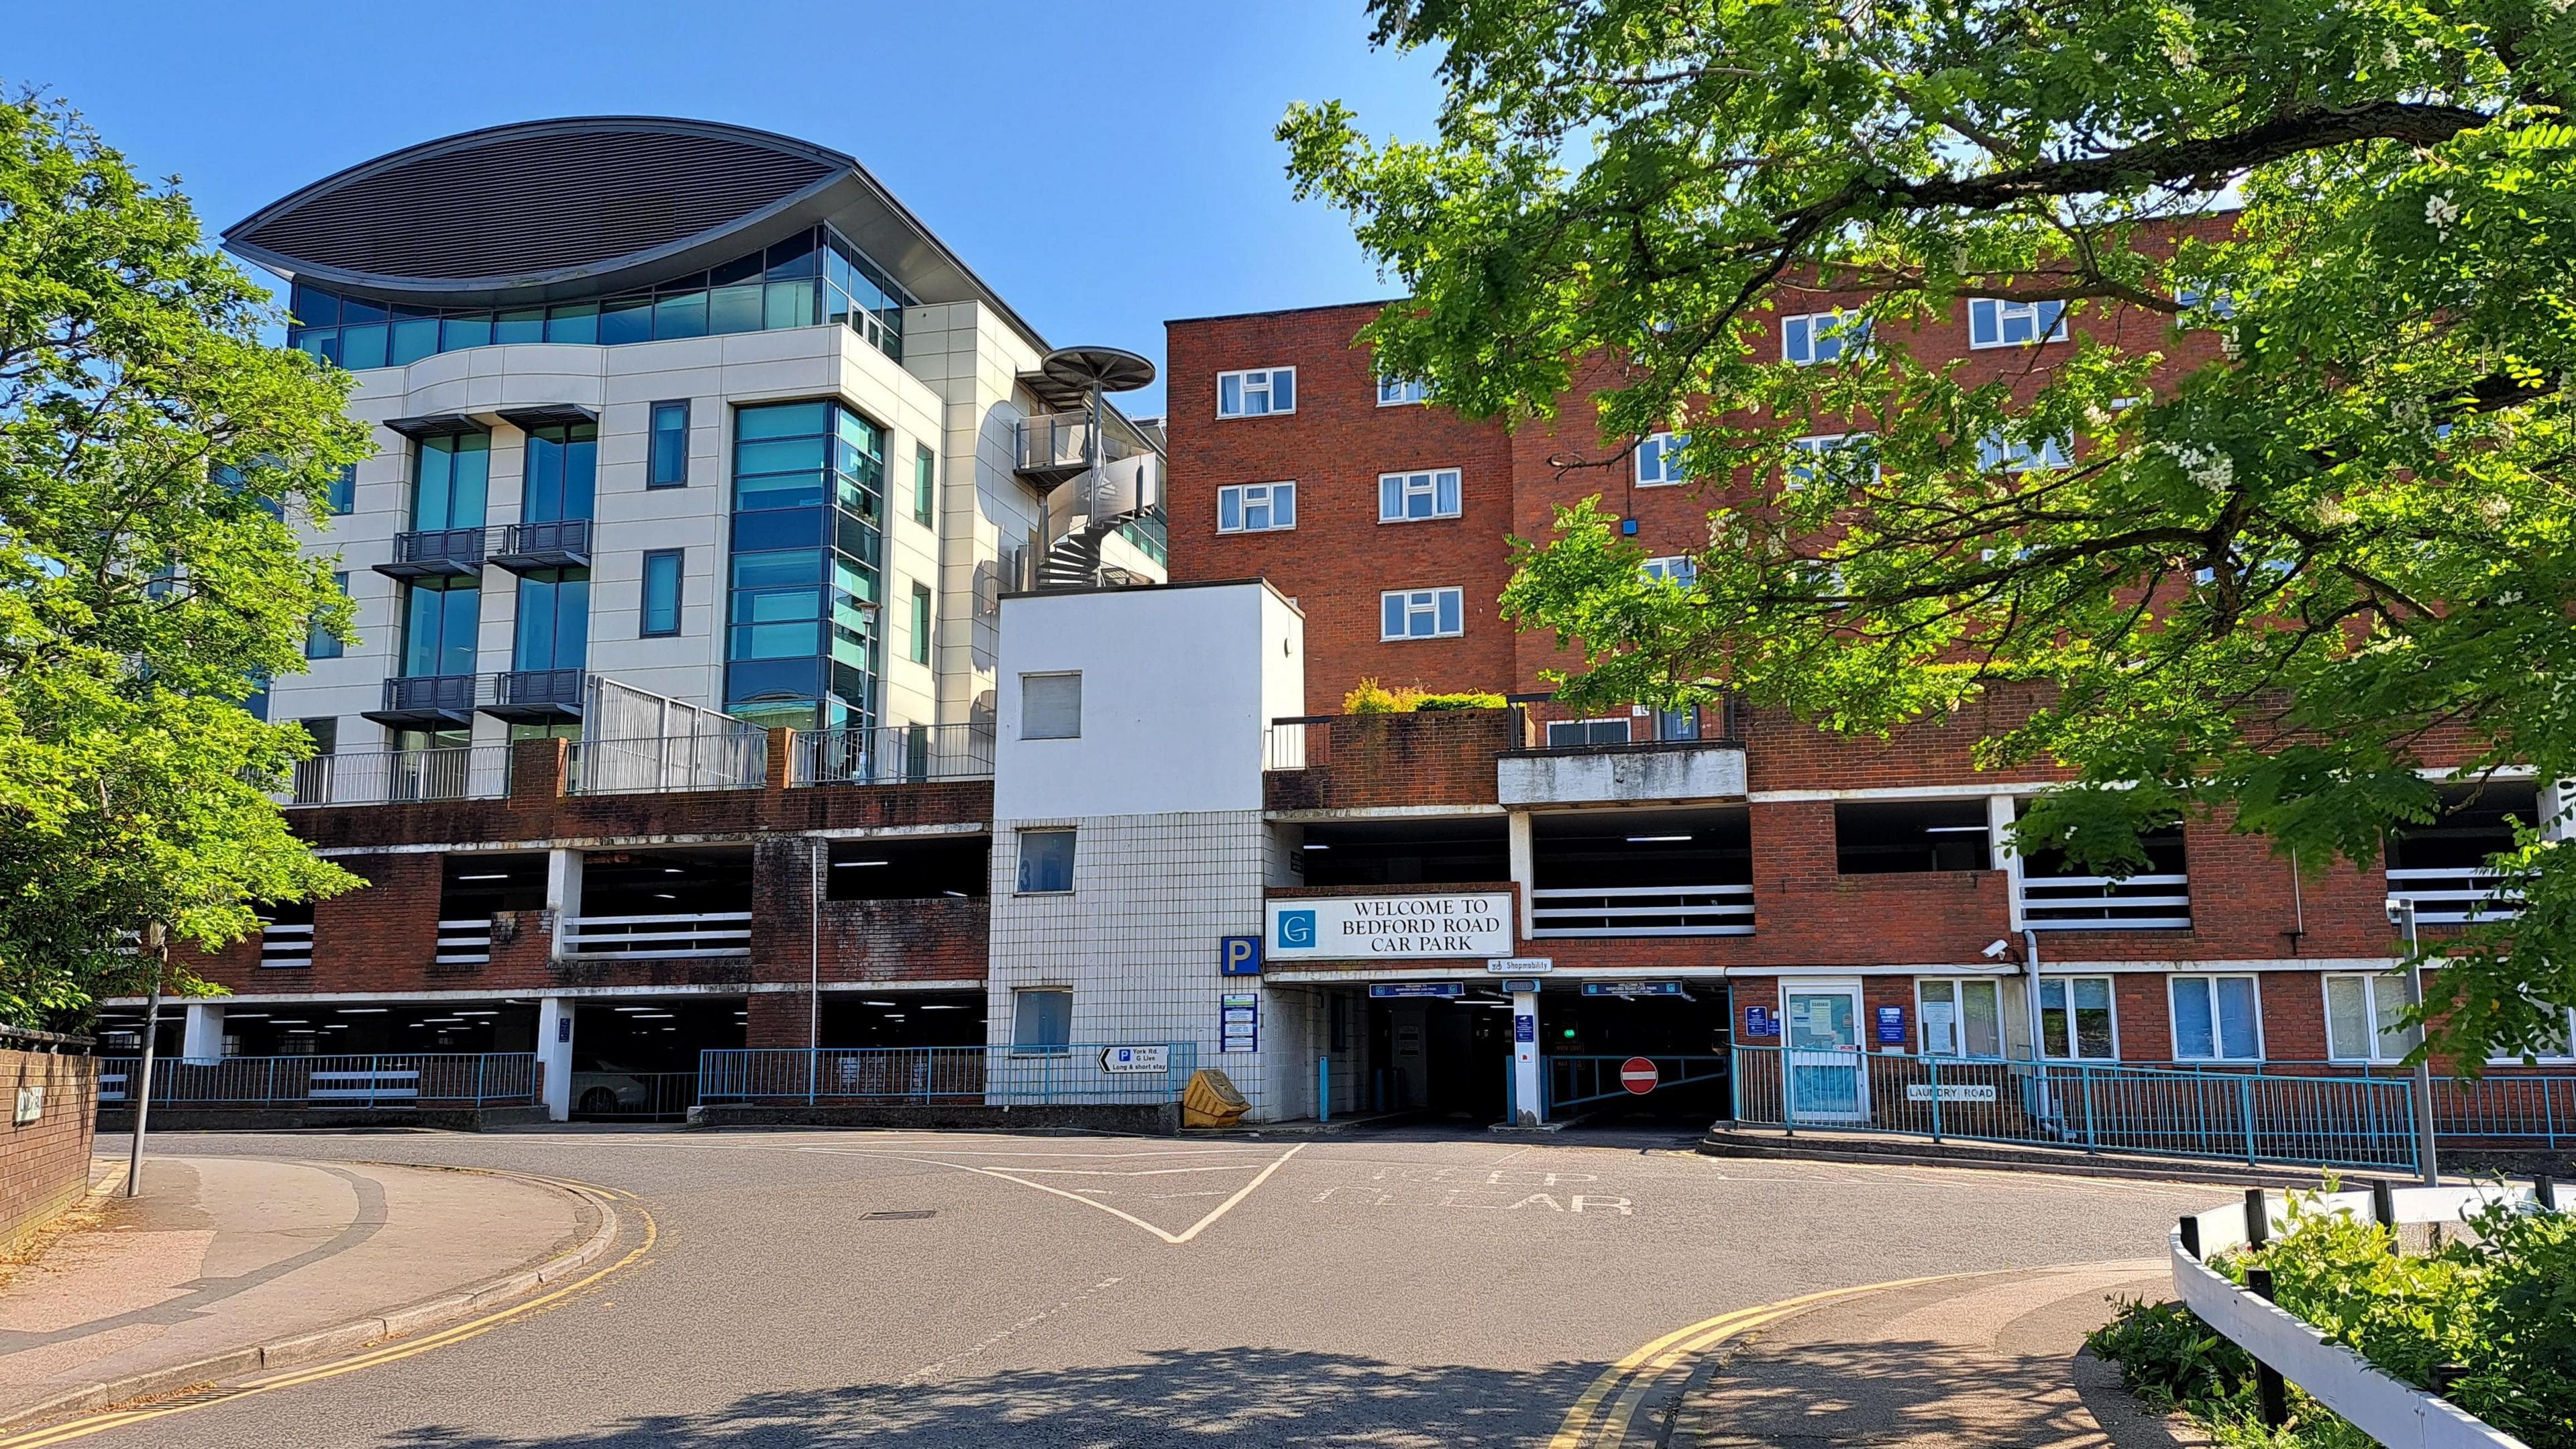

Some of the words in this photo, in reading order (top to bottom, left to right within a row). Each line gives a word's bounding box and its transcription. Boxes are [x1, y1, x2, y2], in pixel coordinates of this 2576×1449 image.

[1020, 859, 1031, 892] 3
[1354, 900, 1454, 916] WELCOME
[1461, 899, 1488, 914] TO
[1284, 916, 1311, 942] G
[1342, 918, 1436, 935] BEDFORD
[1444, 917, 1500, 933] ROAD
[1371, 937, 1413, 952] CAR
[1420, 936, 1473, 951] PARK
[1229, 940, 1252, 971] P
[1507, 961, 1548, 971] Shopmobility
[1121, 1050, 1128, 1061] P
[1964, 1089, 1994, 1097] ROAD
